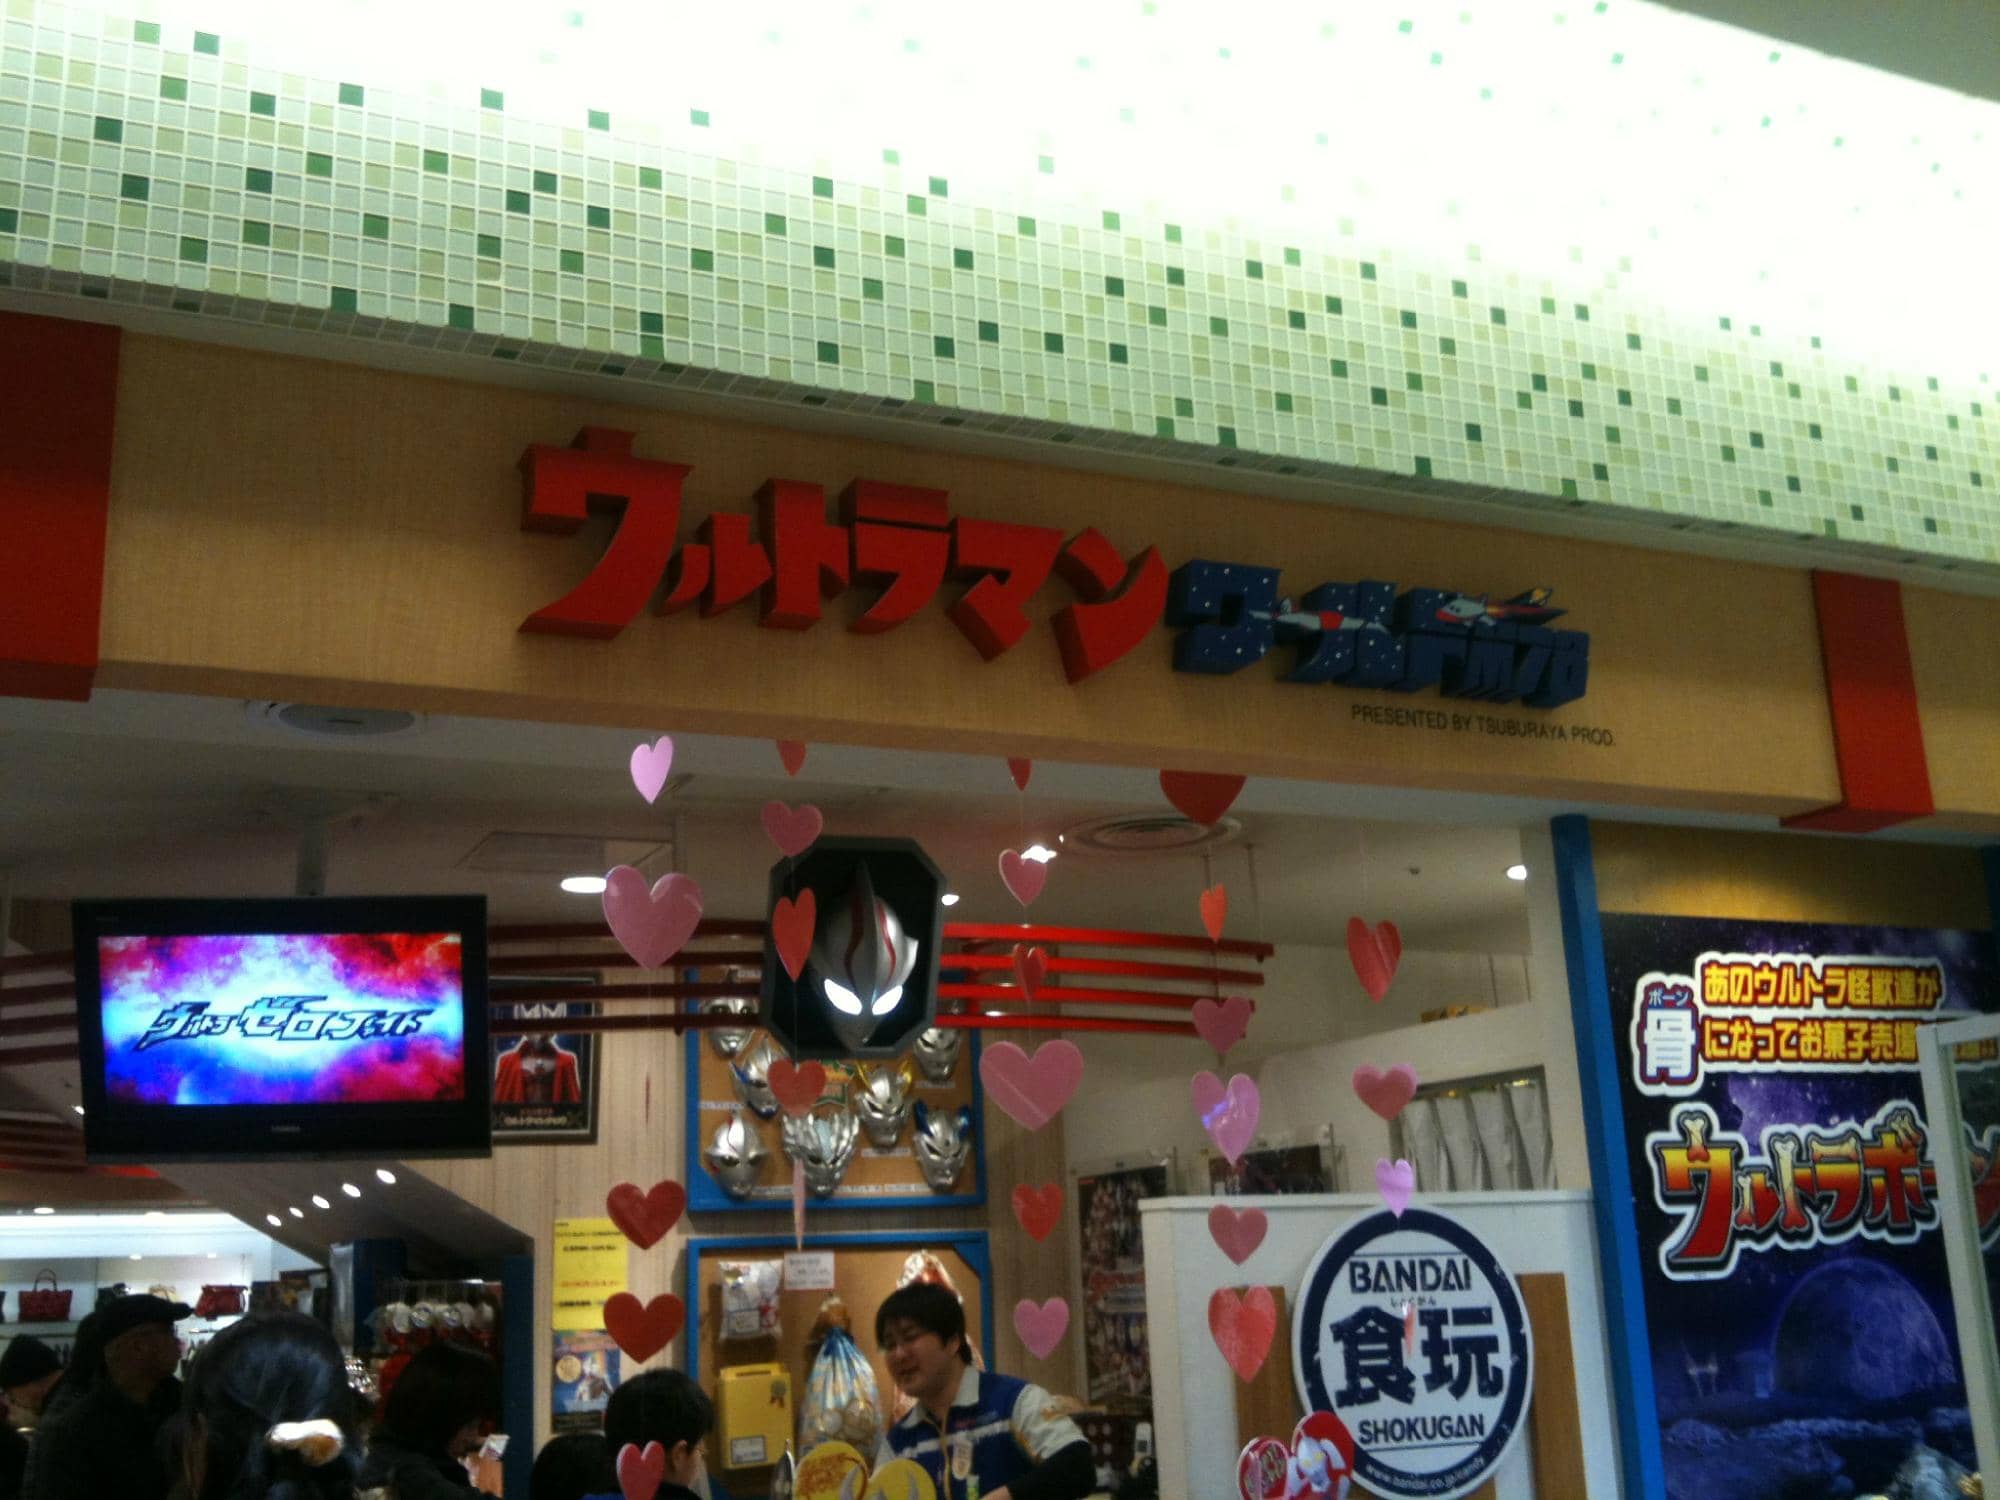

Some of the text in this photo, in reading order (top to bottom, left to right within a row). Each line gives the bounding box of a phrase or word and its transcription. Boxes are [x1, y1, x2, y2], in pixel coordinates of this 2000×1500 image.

[517, 425, 1170, 686] ウルトラマン
[1351, 703, 1448, 730] PRESENTED
[1452, 712, 1473, 732] BY
[1477, 715, 1567, 741] TSUBURAYA
[1648, 987, 1689, 1008] ボーン
[1704, 963, 1938, 1005] あのウルトラ怪獣達が
[1643, 1008, 1696, 1078] 骨
[1349, 1258, 1472, 1294] BANDAI
[1329, 1305, 1504, 1408] 食玩
[1358, 1413, 1485, 1445] SHOKUGAN
